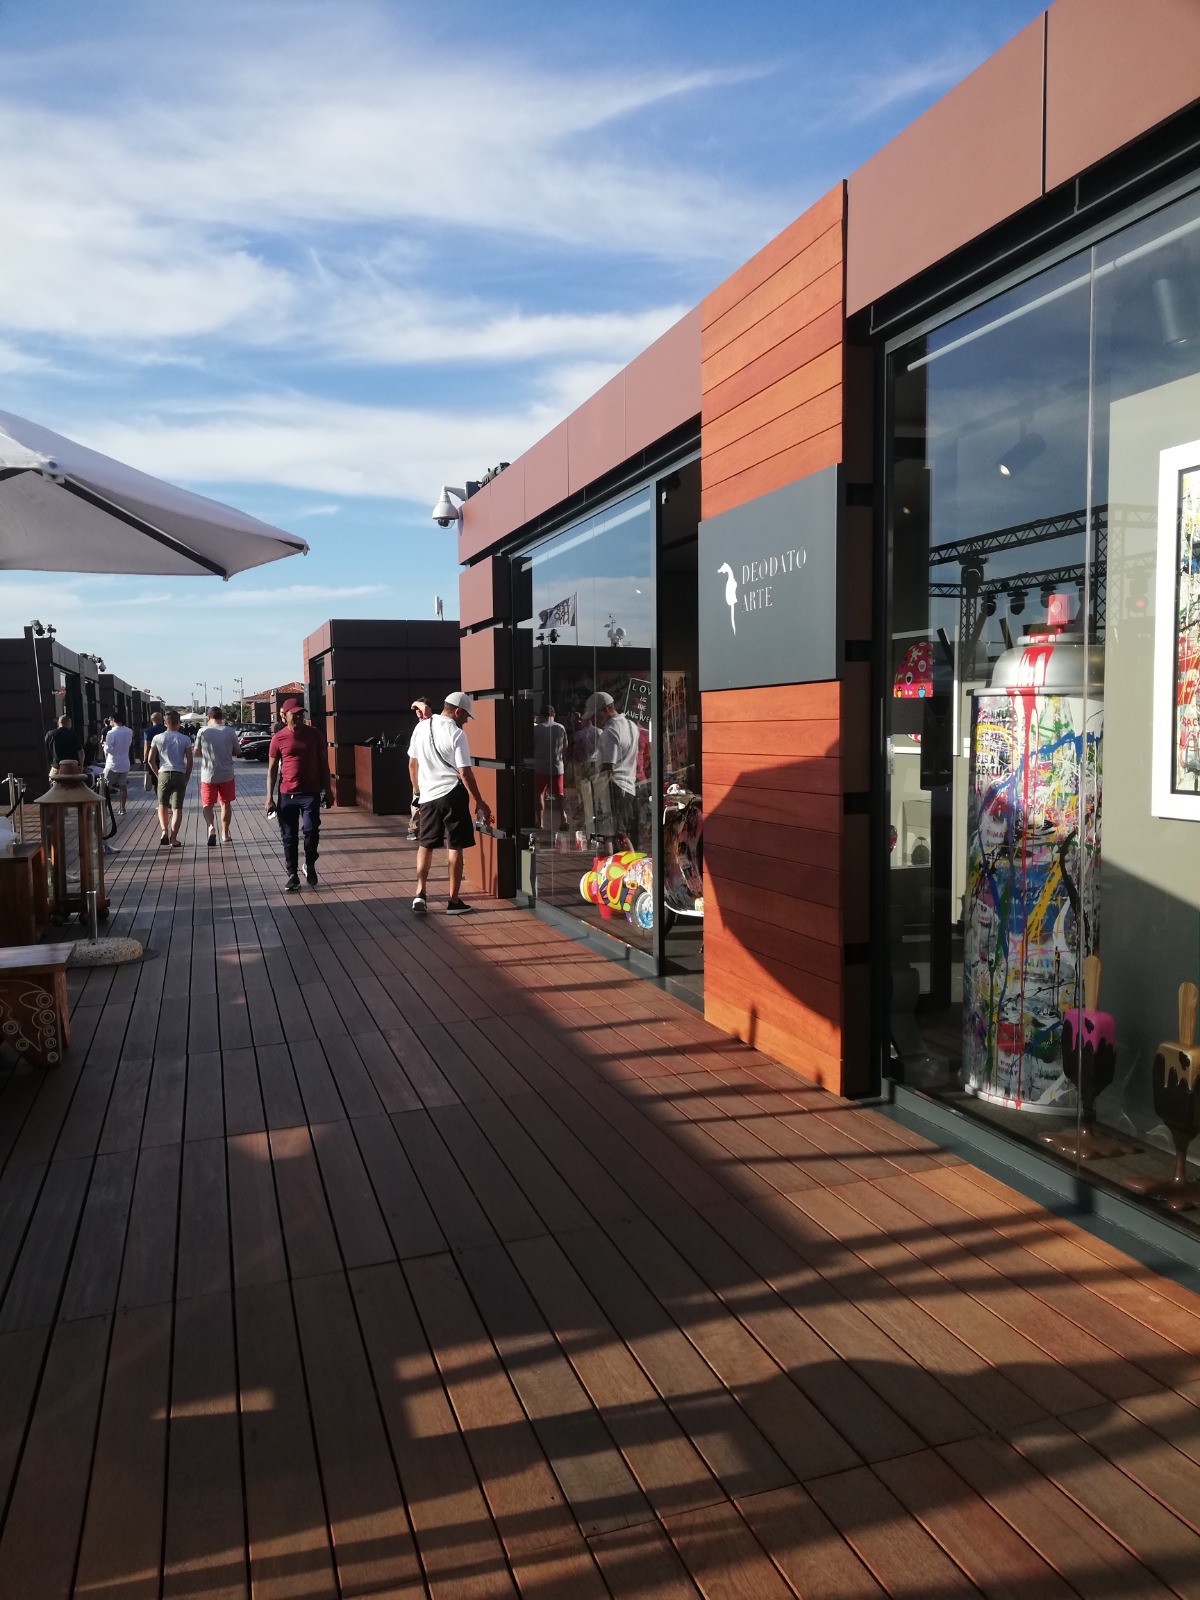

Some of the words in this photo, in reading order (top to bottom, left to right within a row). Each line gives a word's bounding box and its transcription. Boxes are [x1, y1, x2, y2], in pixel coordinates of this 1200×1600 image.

[742, 546, 807, 585] DEODATO
[741, 586, 773, 613] ARTE
[632, 683, 652, 696] LOV
[625, 710, 651, 723] ANSWE
